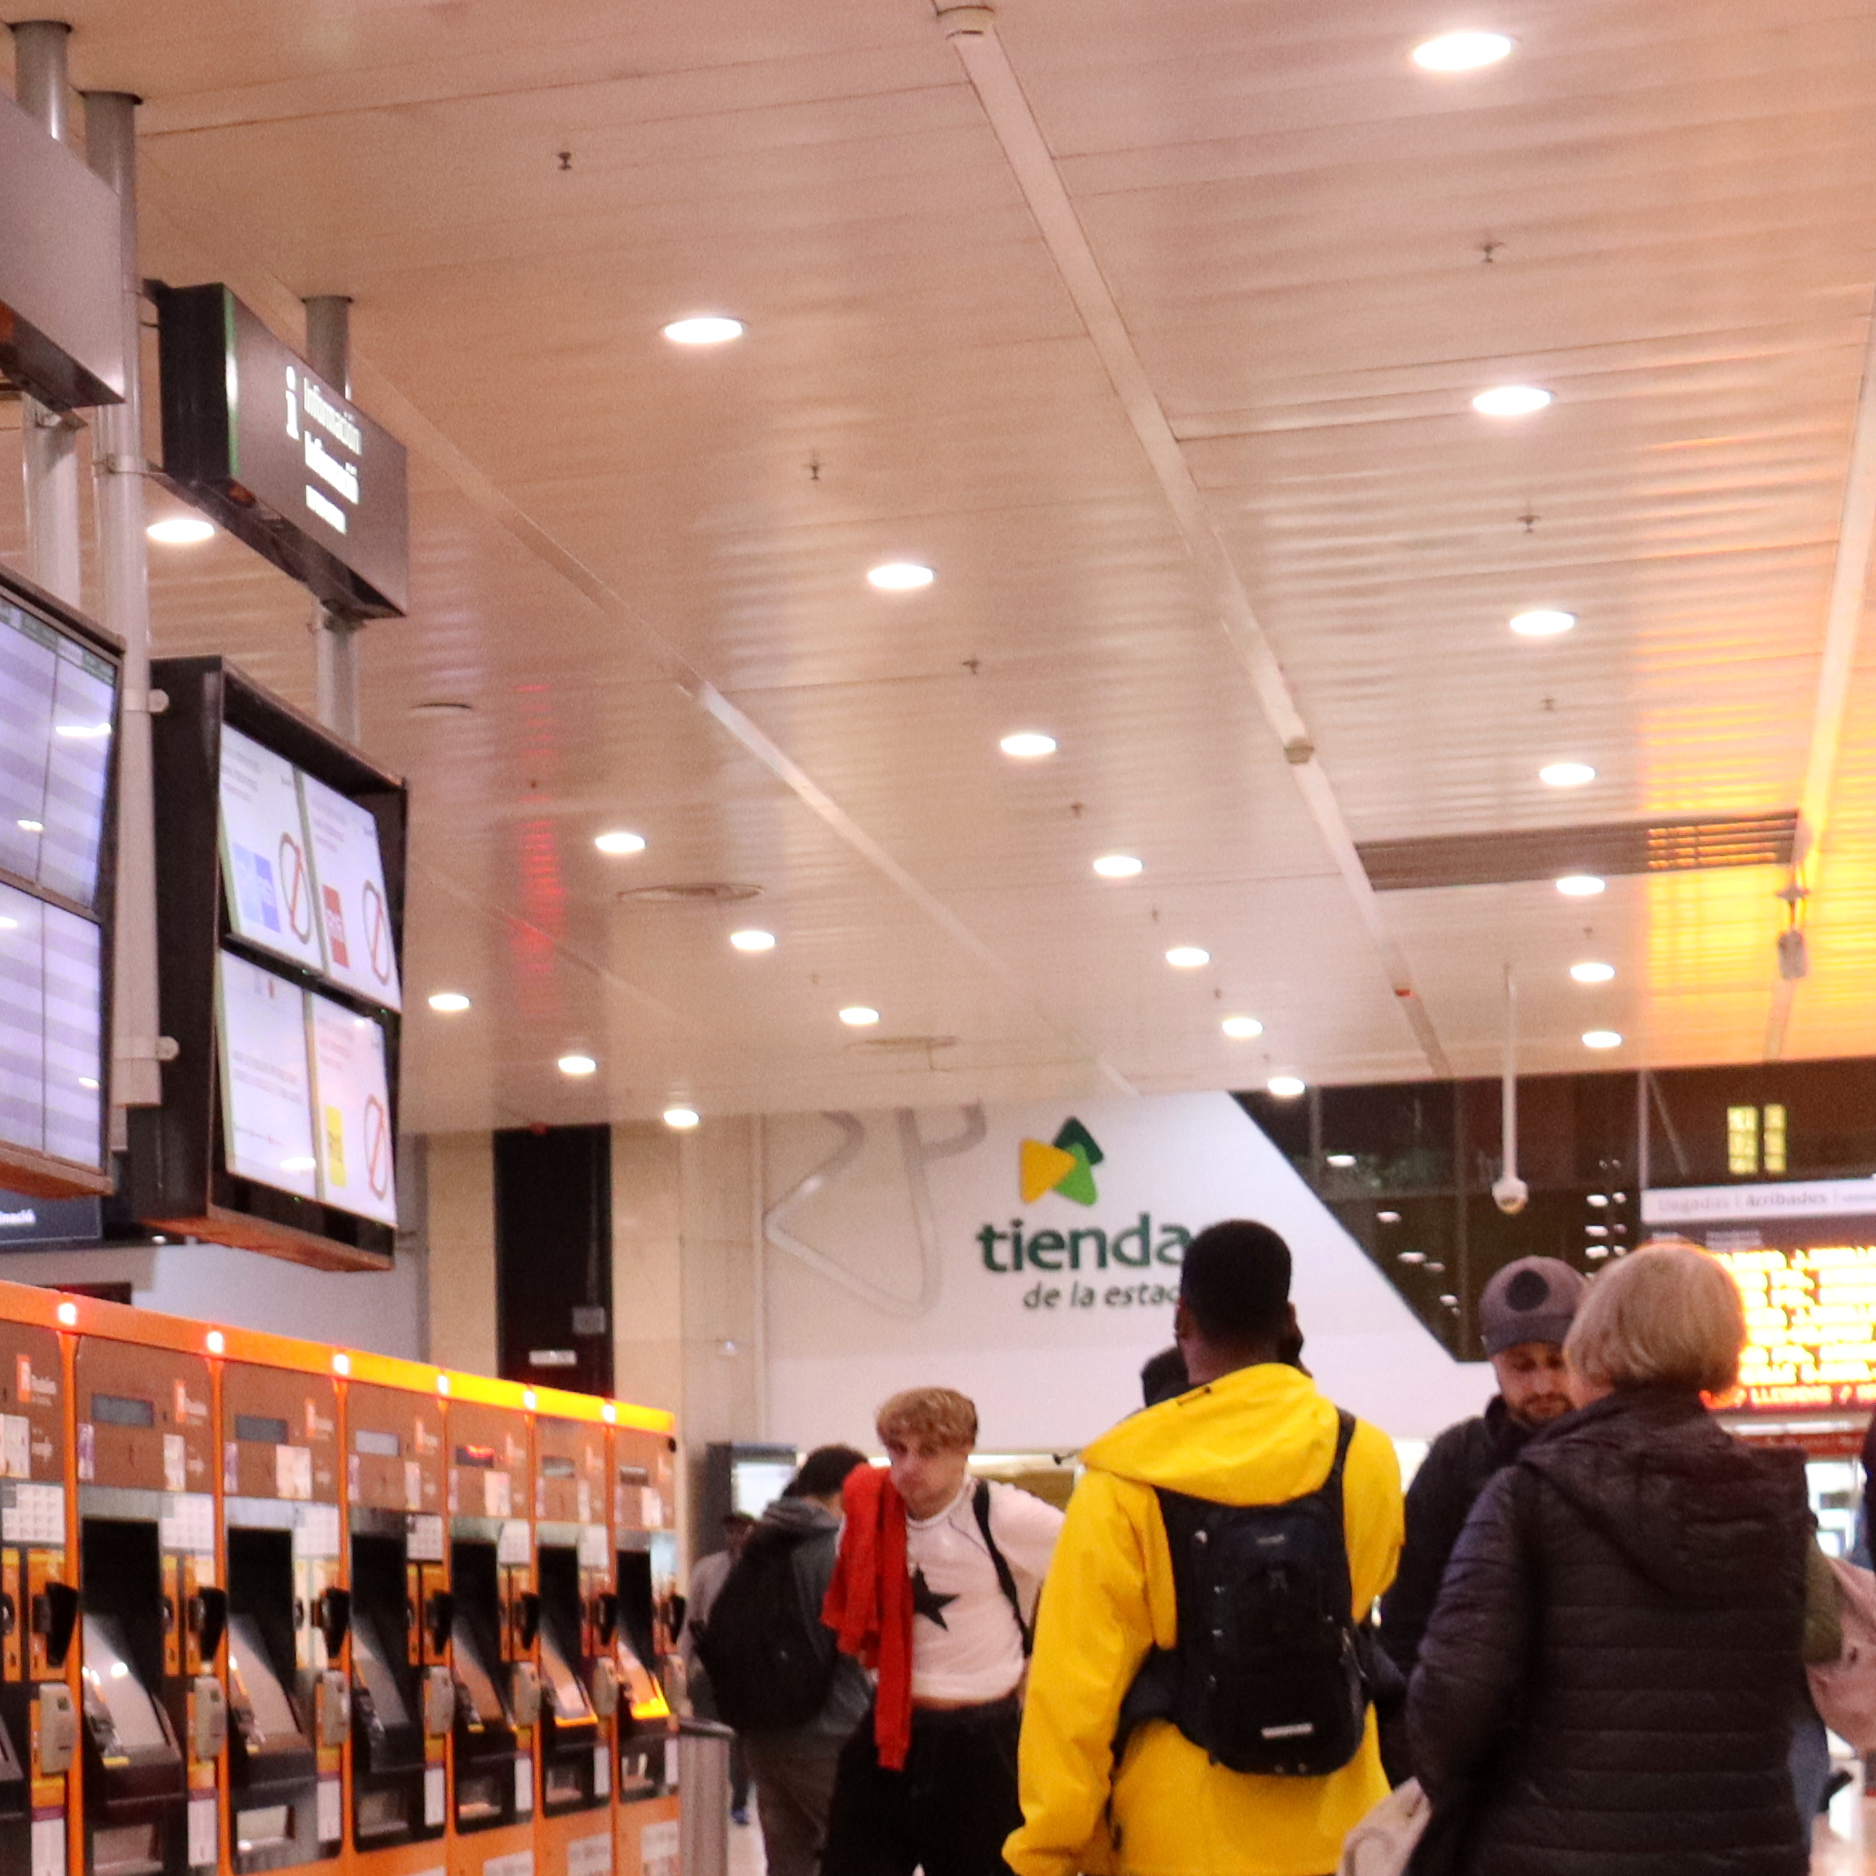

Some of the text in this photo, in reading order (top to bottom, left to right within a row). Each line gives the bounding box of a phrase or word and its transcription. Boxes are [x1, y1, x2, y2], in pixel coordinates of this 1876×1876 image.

[1023, 1280, 1179, 1308] de la estac
